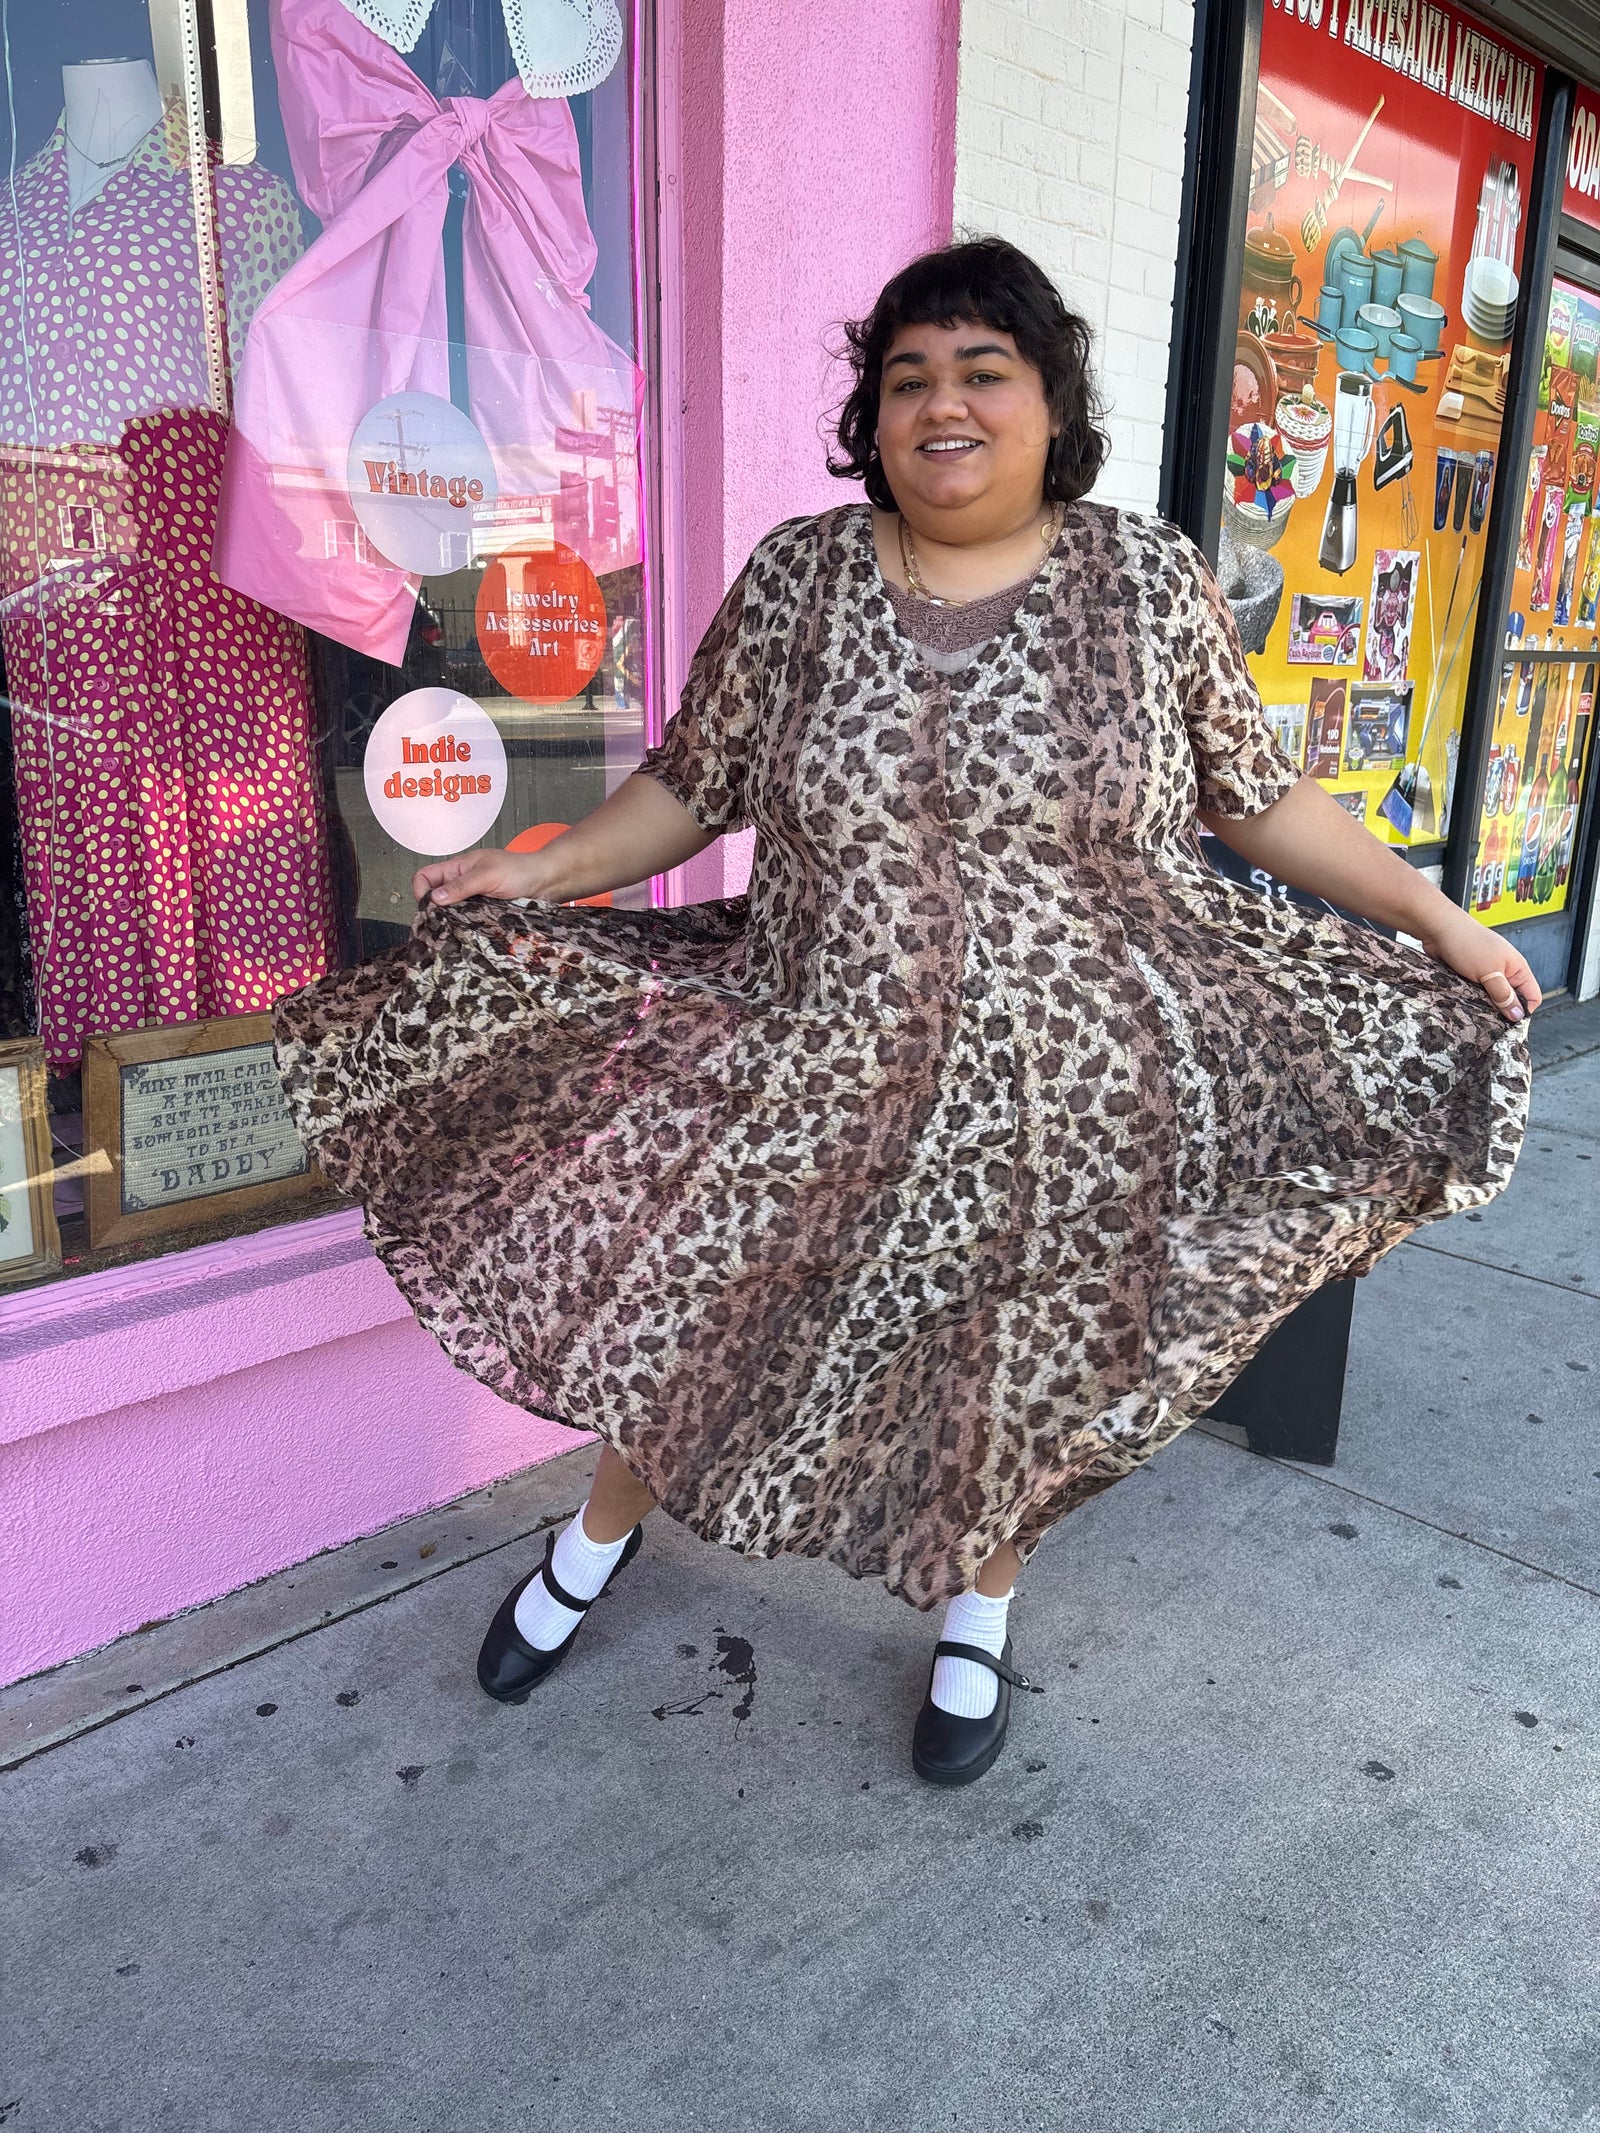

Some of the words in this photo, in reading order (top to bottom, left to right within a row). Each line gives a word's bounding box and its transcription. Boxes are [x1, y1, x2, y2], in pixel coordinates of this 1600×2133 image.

[1344, 0, 1451, 98] ARTESANIA
[1448, 21, 1537, 142] MEXICANA
[1565, 105, 1600, 201] ODA
[1551, 400, 1571, 418] Doritos
[1577, 423, 1599, 443] Tostitos
[363, 460, 484, 508] Vintage
[506, 589, 579, 613] Jewelry
[485, 611, 600, 633] Accessories
[529, 637, 560, 657] Art
[1327, 729, 1339, 740] 100
[401, 735, 472, 764] Indie
[384, 768, 492, 803] designs
[1483, 863, 1492, 885] G
[138, 1076, 178, 1095] ANY
[184, 1069, 227, 1088] MAN
[234, 1061, 271, 1079] CAN
[133, 1122, 223, 1150] SOMEONE
[228, 1109, 291, 1131] SPECIA
[151, 1110, 192, 1129] BUT
[186, 1143, 209, 1158] TO
[218, 1137, 238, 1152] BE
[244, 1133, 255, 1146] A
